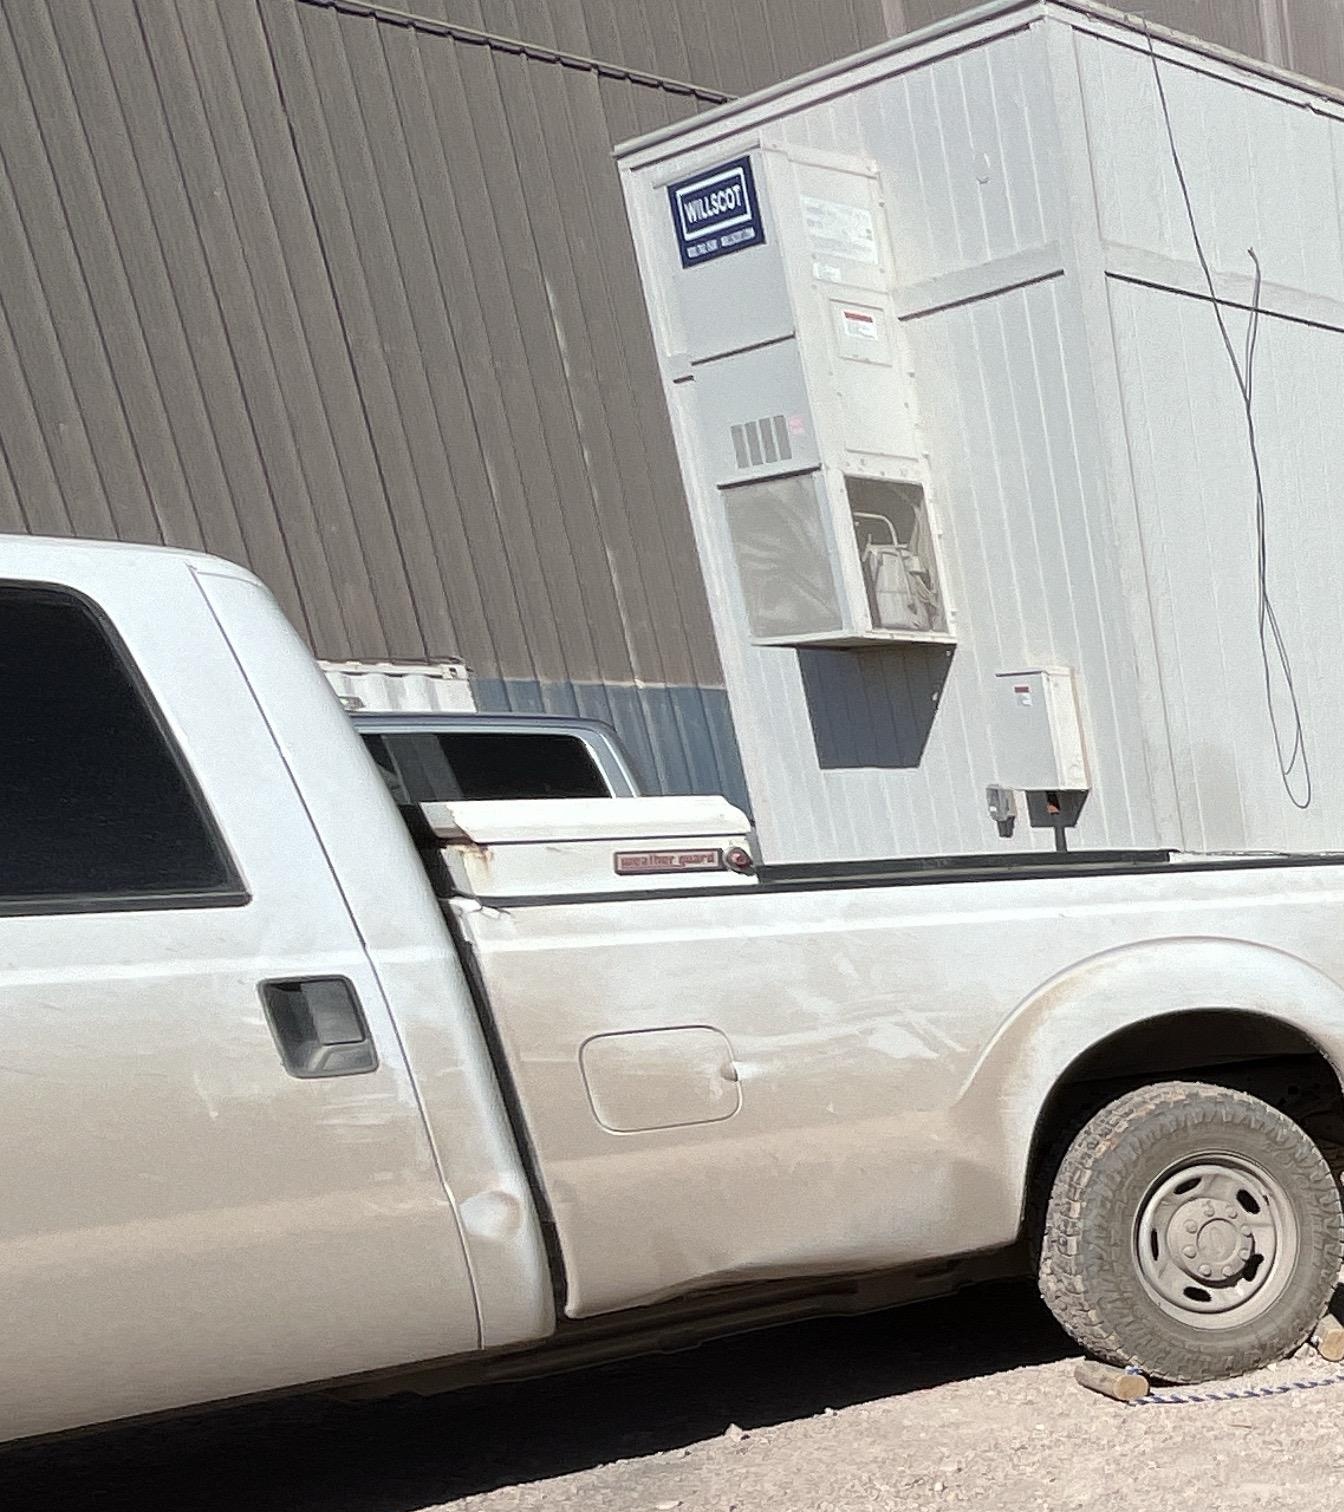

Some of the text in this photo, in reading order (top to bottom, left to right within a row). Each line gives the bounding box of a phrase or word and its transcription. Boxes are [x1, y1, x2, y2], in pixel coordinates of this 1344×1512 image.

[683, 183, 743, 224] WILLSCOT
[621, 852, 715, 868] weather guard
